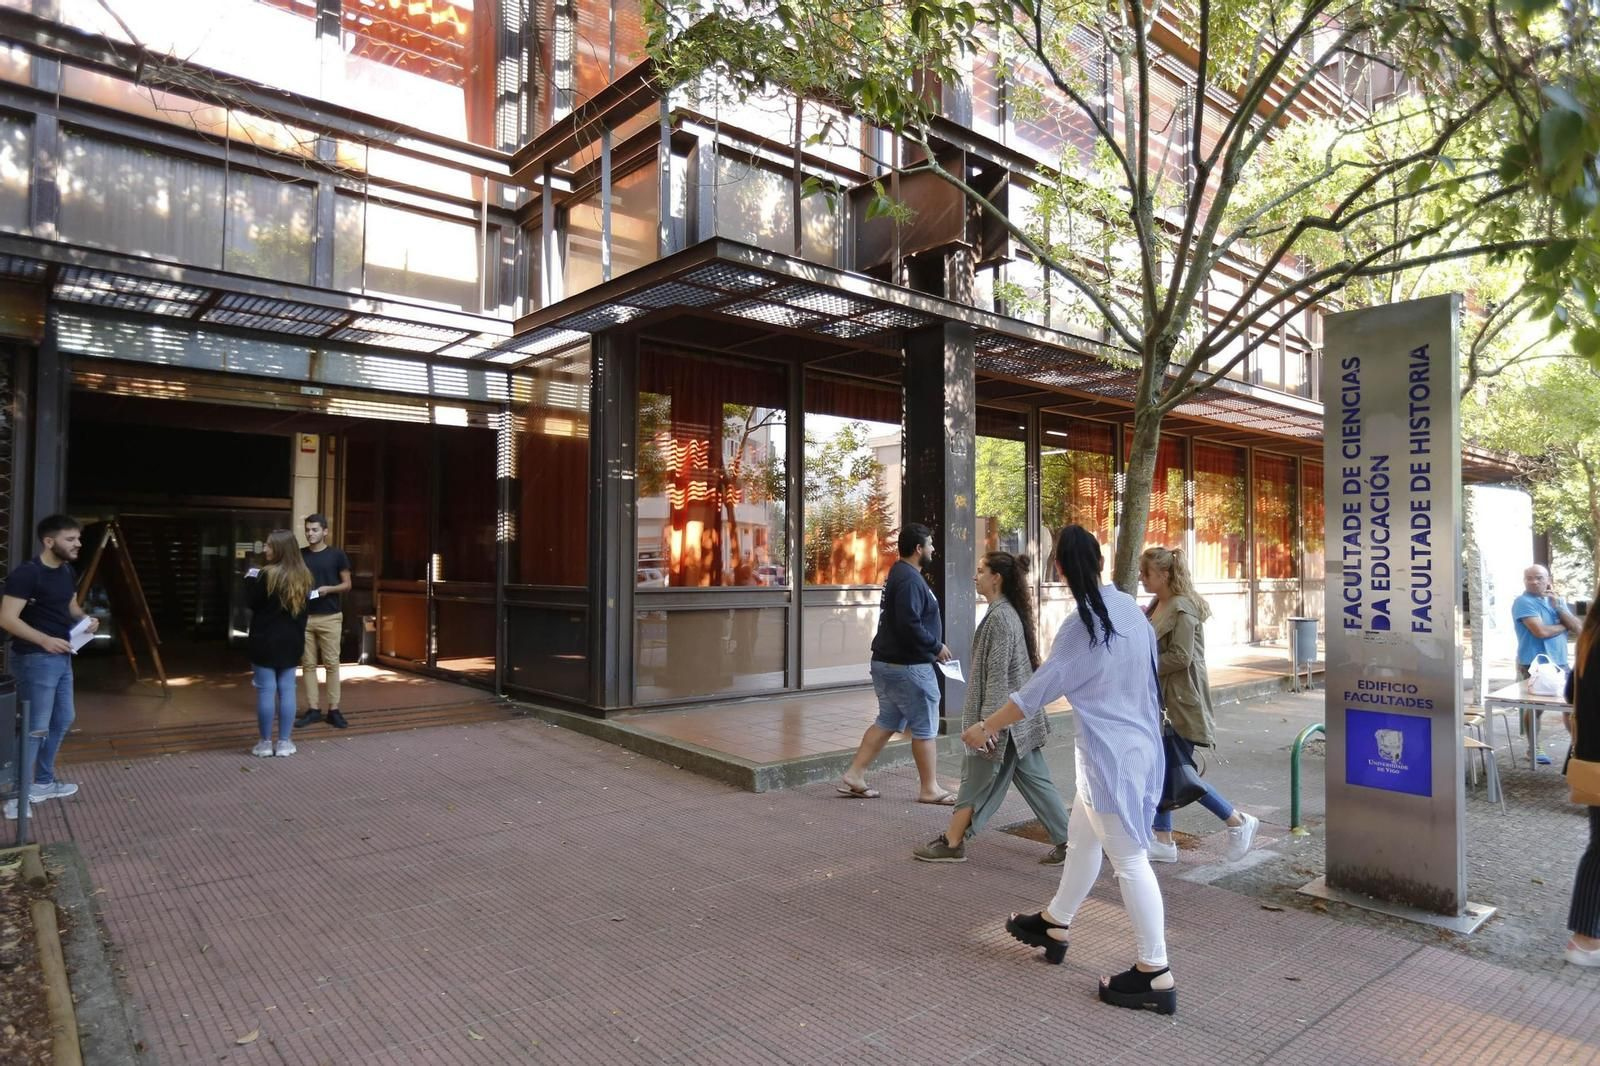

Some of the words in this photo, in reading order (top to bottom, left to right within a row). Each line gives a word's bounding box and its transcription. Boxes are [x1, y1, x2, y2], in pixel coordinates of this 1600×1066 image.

[1342, 357, 1361, 459] CIENCIAS
[1409, 344, 1431, 455] HISTORIA
[1343, 466, 1361, 495] DE
[1410, 462, 1431, 492] DE
[1364, 455, 1390, 591] EDUCACIÓN
[1343, 502, 1362, 630] FACULTADE
[1411, 500, 1432, 633] FACULTADE
[1371, 599, 1390, 631] DA
[1344, 691, 1433, 710] FACULTADES
[1358, 679, 1418, 694] EDIFICIO
